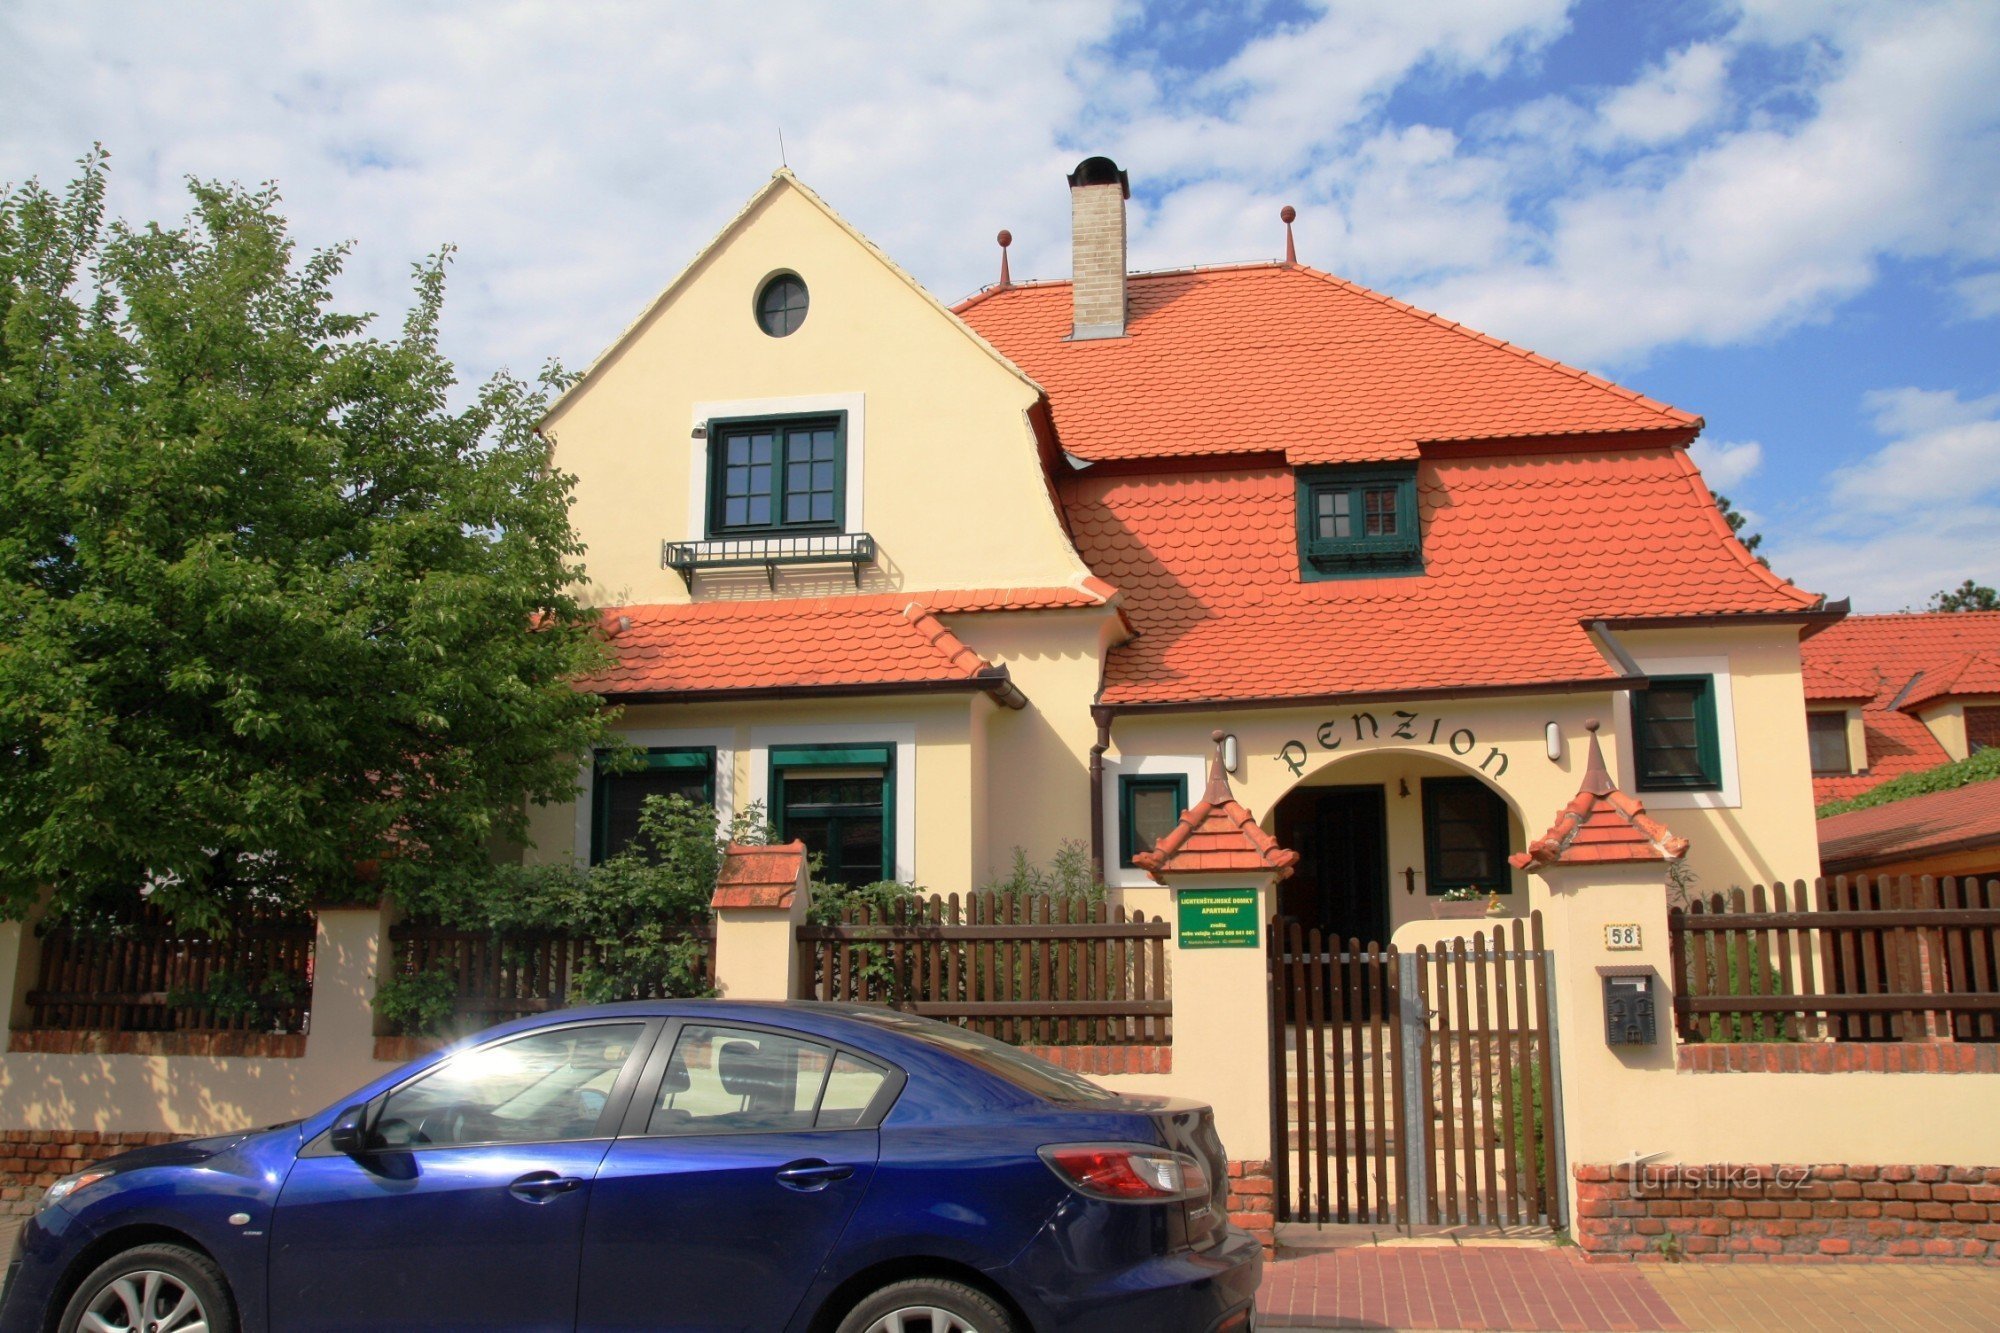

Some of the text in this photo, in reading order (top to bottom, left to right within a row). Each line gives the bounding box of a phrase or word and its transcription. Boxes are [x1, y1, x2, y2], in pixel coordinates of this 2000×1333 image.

[1273, 710, 1509, 780] PENZION
[1201, 906, 1239, 914] APARTMÁNY
[1612, 928, 1633, 944] 58
